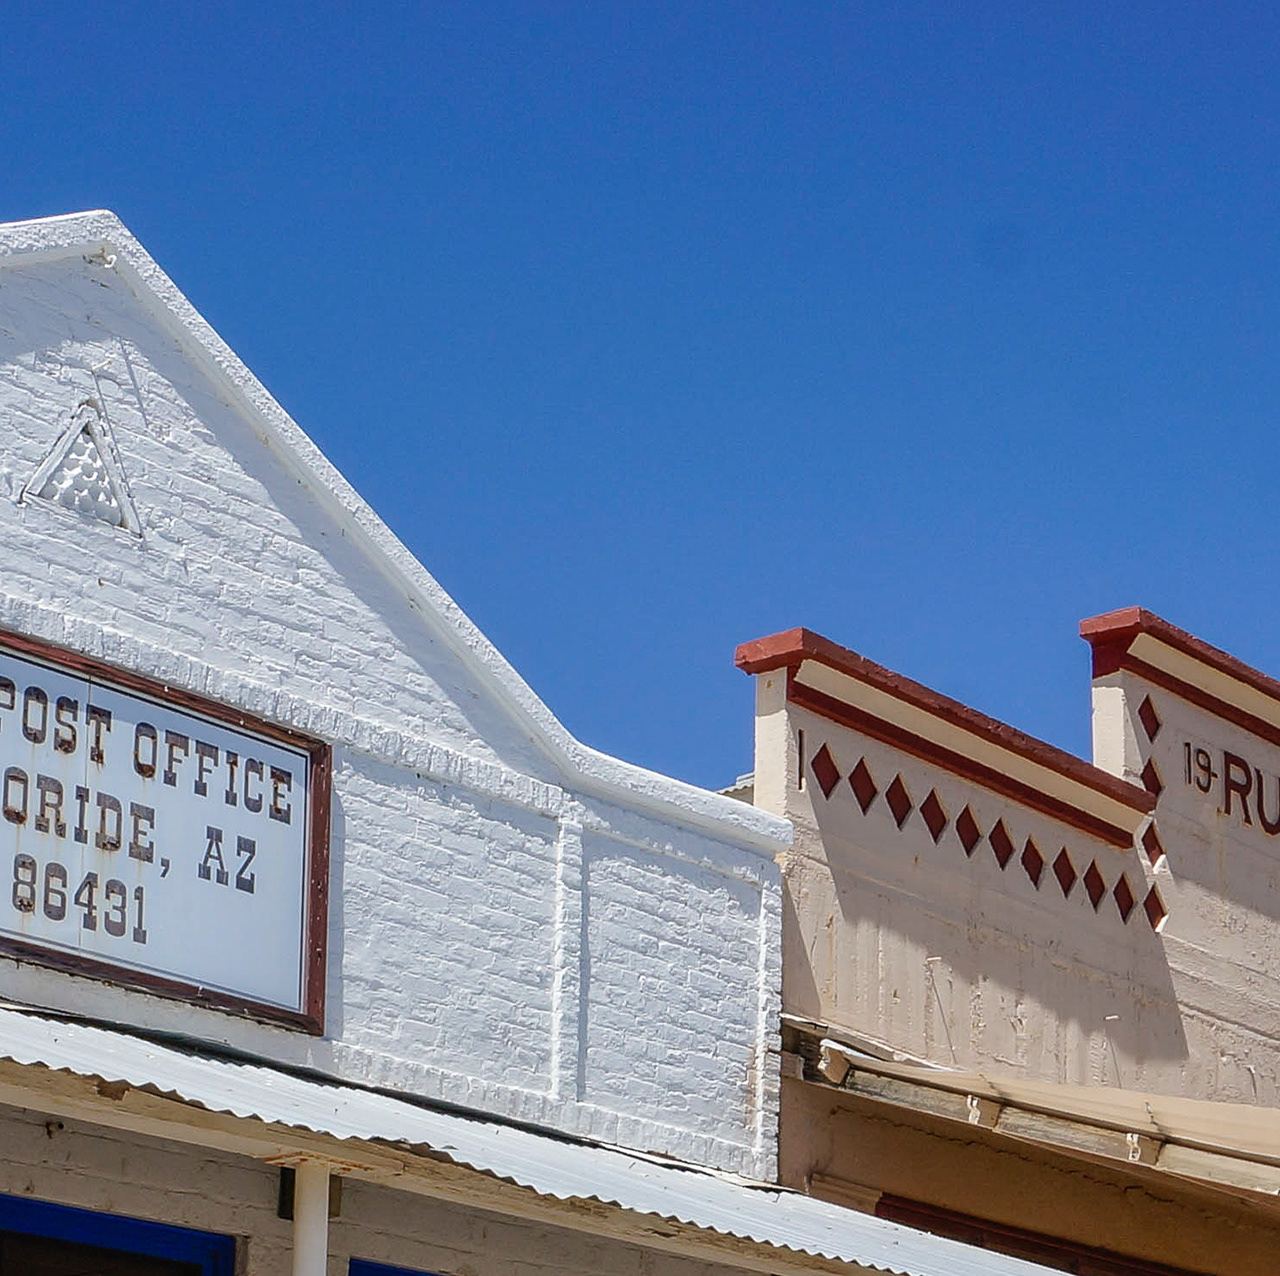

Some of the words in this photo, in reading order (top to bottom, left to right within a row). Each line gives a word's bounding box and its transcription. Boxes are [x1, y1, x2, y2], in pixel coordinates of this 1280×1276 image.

[134, 721, 292, 825] OFFICE
[11, 853, 148, 945] 86431
[197, 825, 257, 895] AZ
